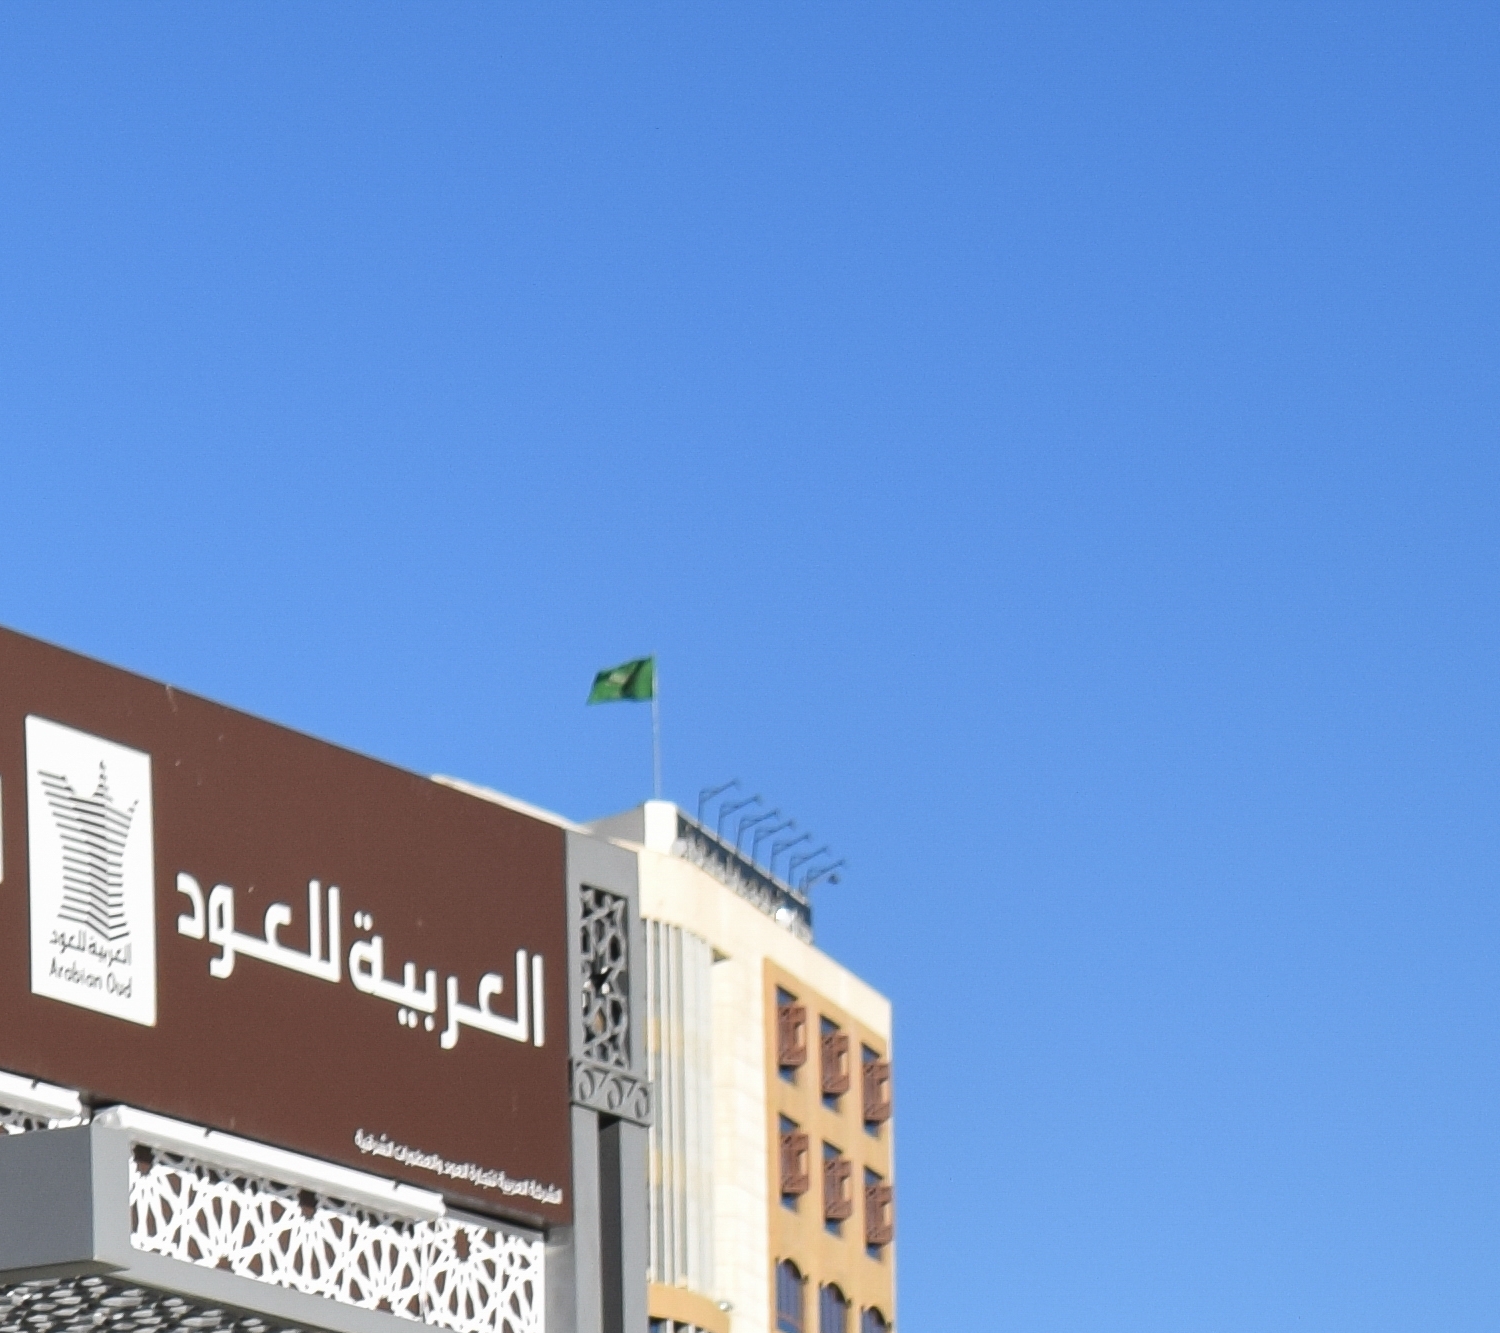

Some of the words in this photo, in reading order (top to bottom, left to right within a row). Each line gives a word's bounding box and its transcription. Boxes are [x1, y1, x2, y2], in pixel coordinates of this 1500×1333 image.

[48, 957, 103, 990] Arabian
[106, 971, 132, 999] Oud
[176, 872, 342, 983] للعود
[351, 909, 545, 1050] العربية
